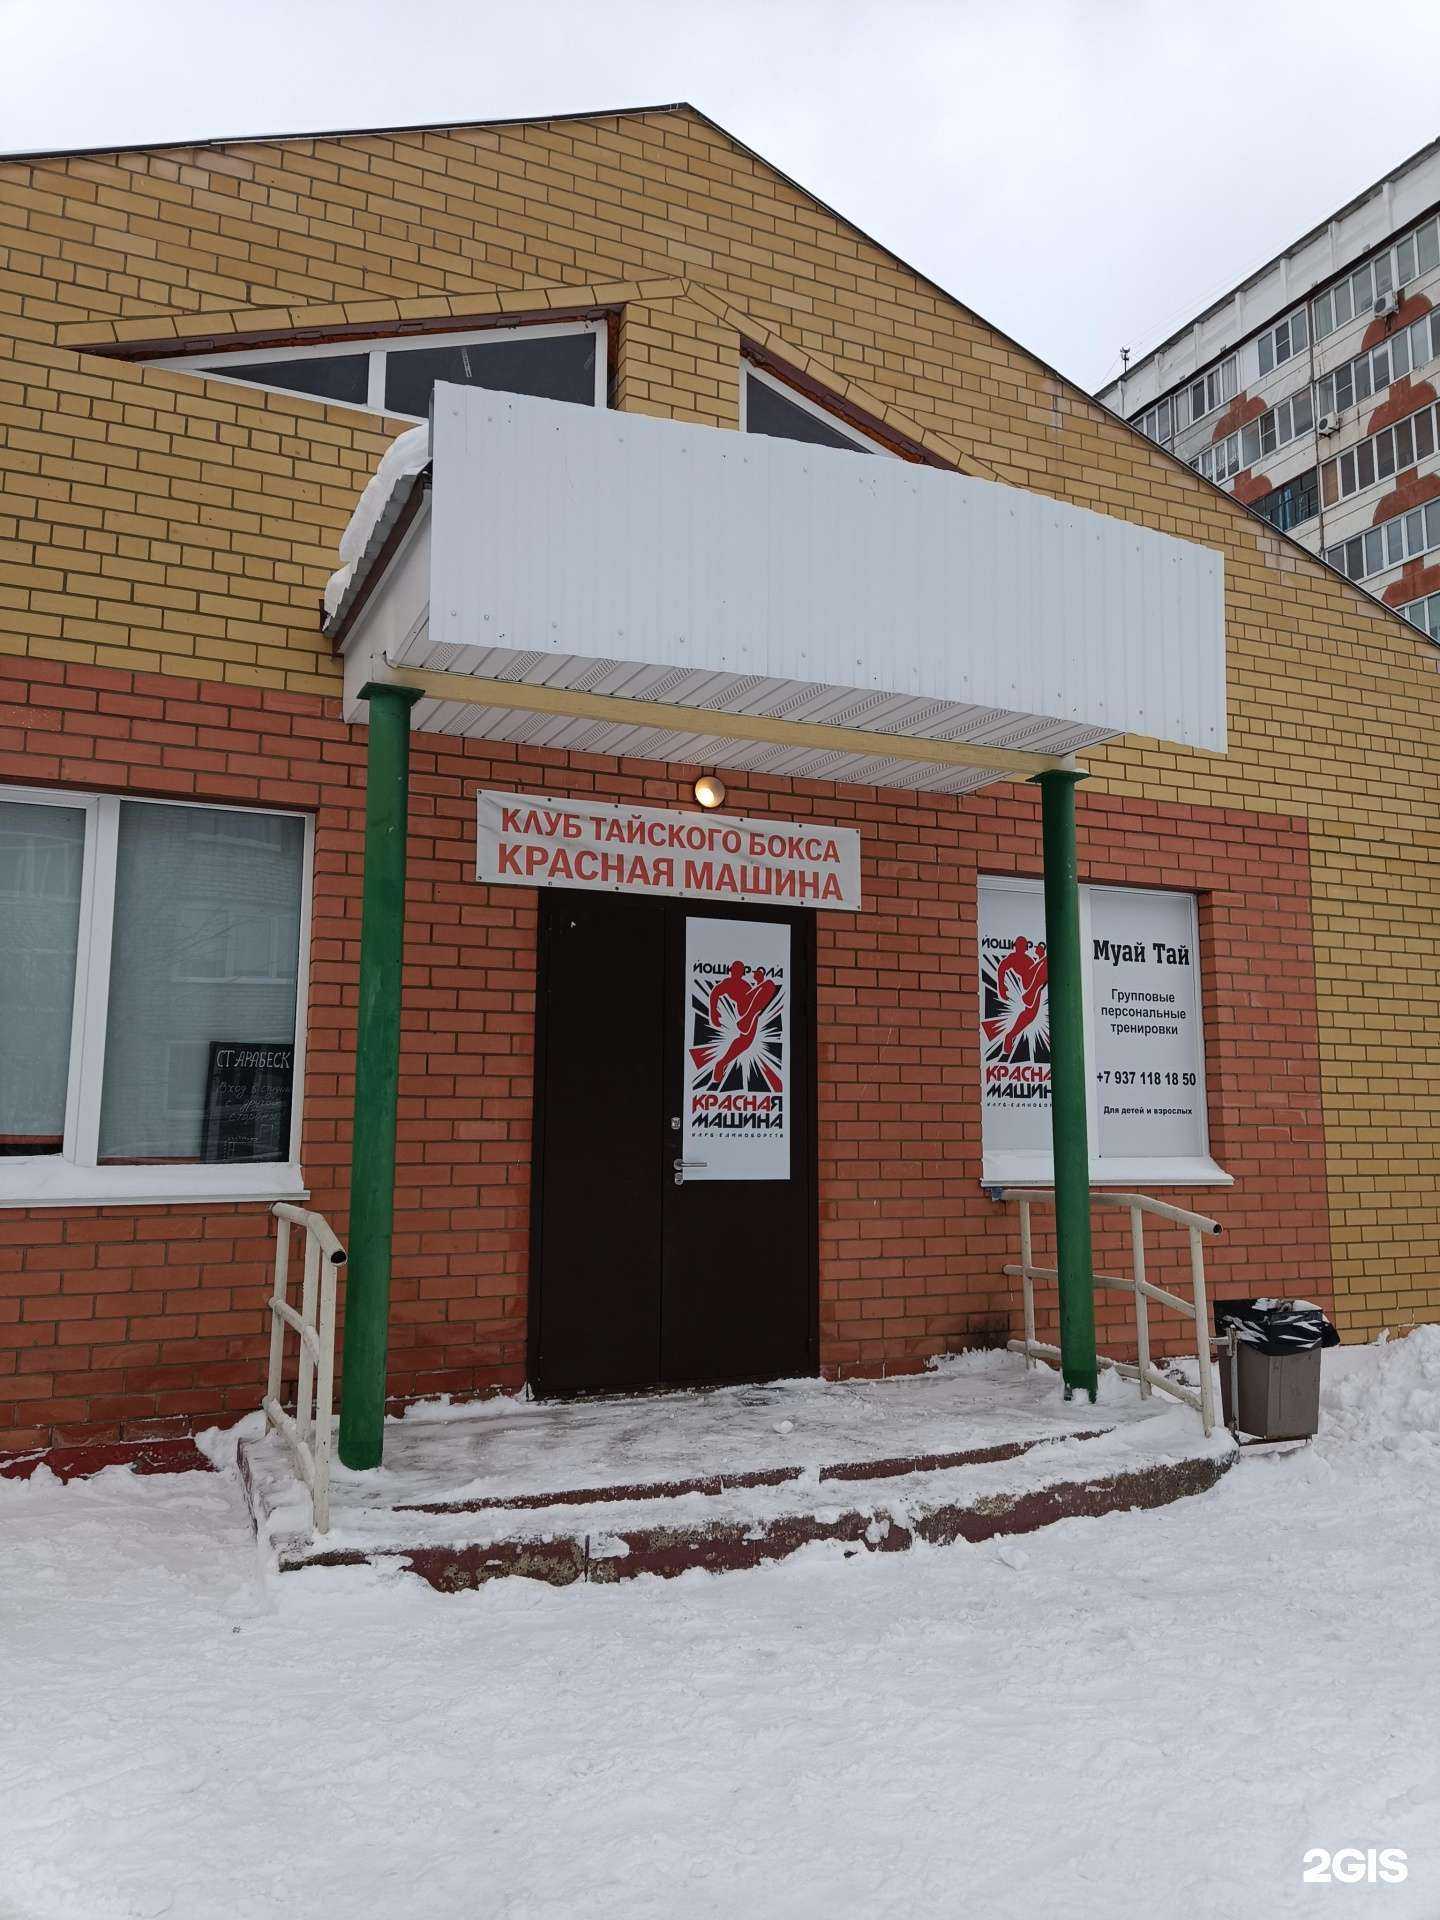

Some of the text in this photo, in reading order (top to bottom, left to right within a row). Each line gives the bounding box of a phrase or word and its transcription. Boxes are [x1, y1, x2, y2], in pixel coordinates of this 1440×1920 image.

[501, 807, 841, 863] КЛУБ ТАЙСКОГО БОКСА
[497, 843, 844, 901] КРАСНАЯ МАШИНА
[1093, 939, 1190, 966] Муай Тай
[1111, 988, 1176, 1004] Групповые
[1101, 1006, 1187, 1023] персональные
[1110, 1022, 1178, 1037] тренировки
[216, 1050, 291, 1069] СТ АРАБЕСК
[1097, 1071, 1196, 1086] +7 937 118 18 50
[986, 1083, 1052, 1099] МАШИН
[692, 1094, 784, 1114] КРАСНАЯ
[1103, 1106, 1119, 1115] Для
[1121, 1106, 1144, 1115] детей
[1153, 1107, 1192, 1116] взрослых
[691, 1112, 784, 1129] МАШИНА
